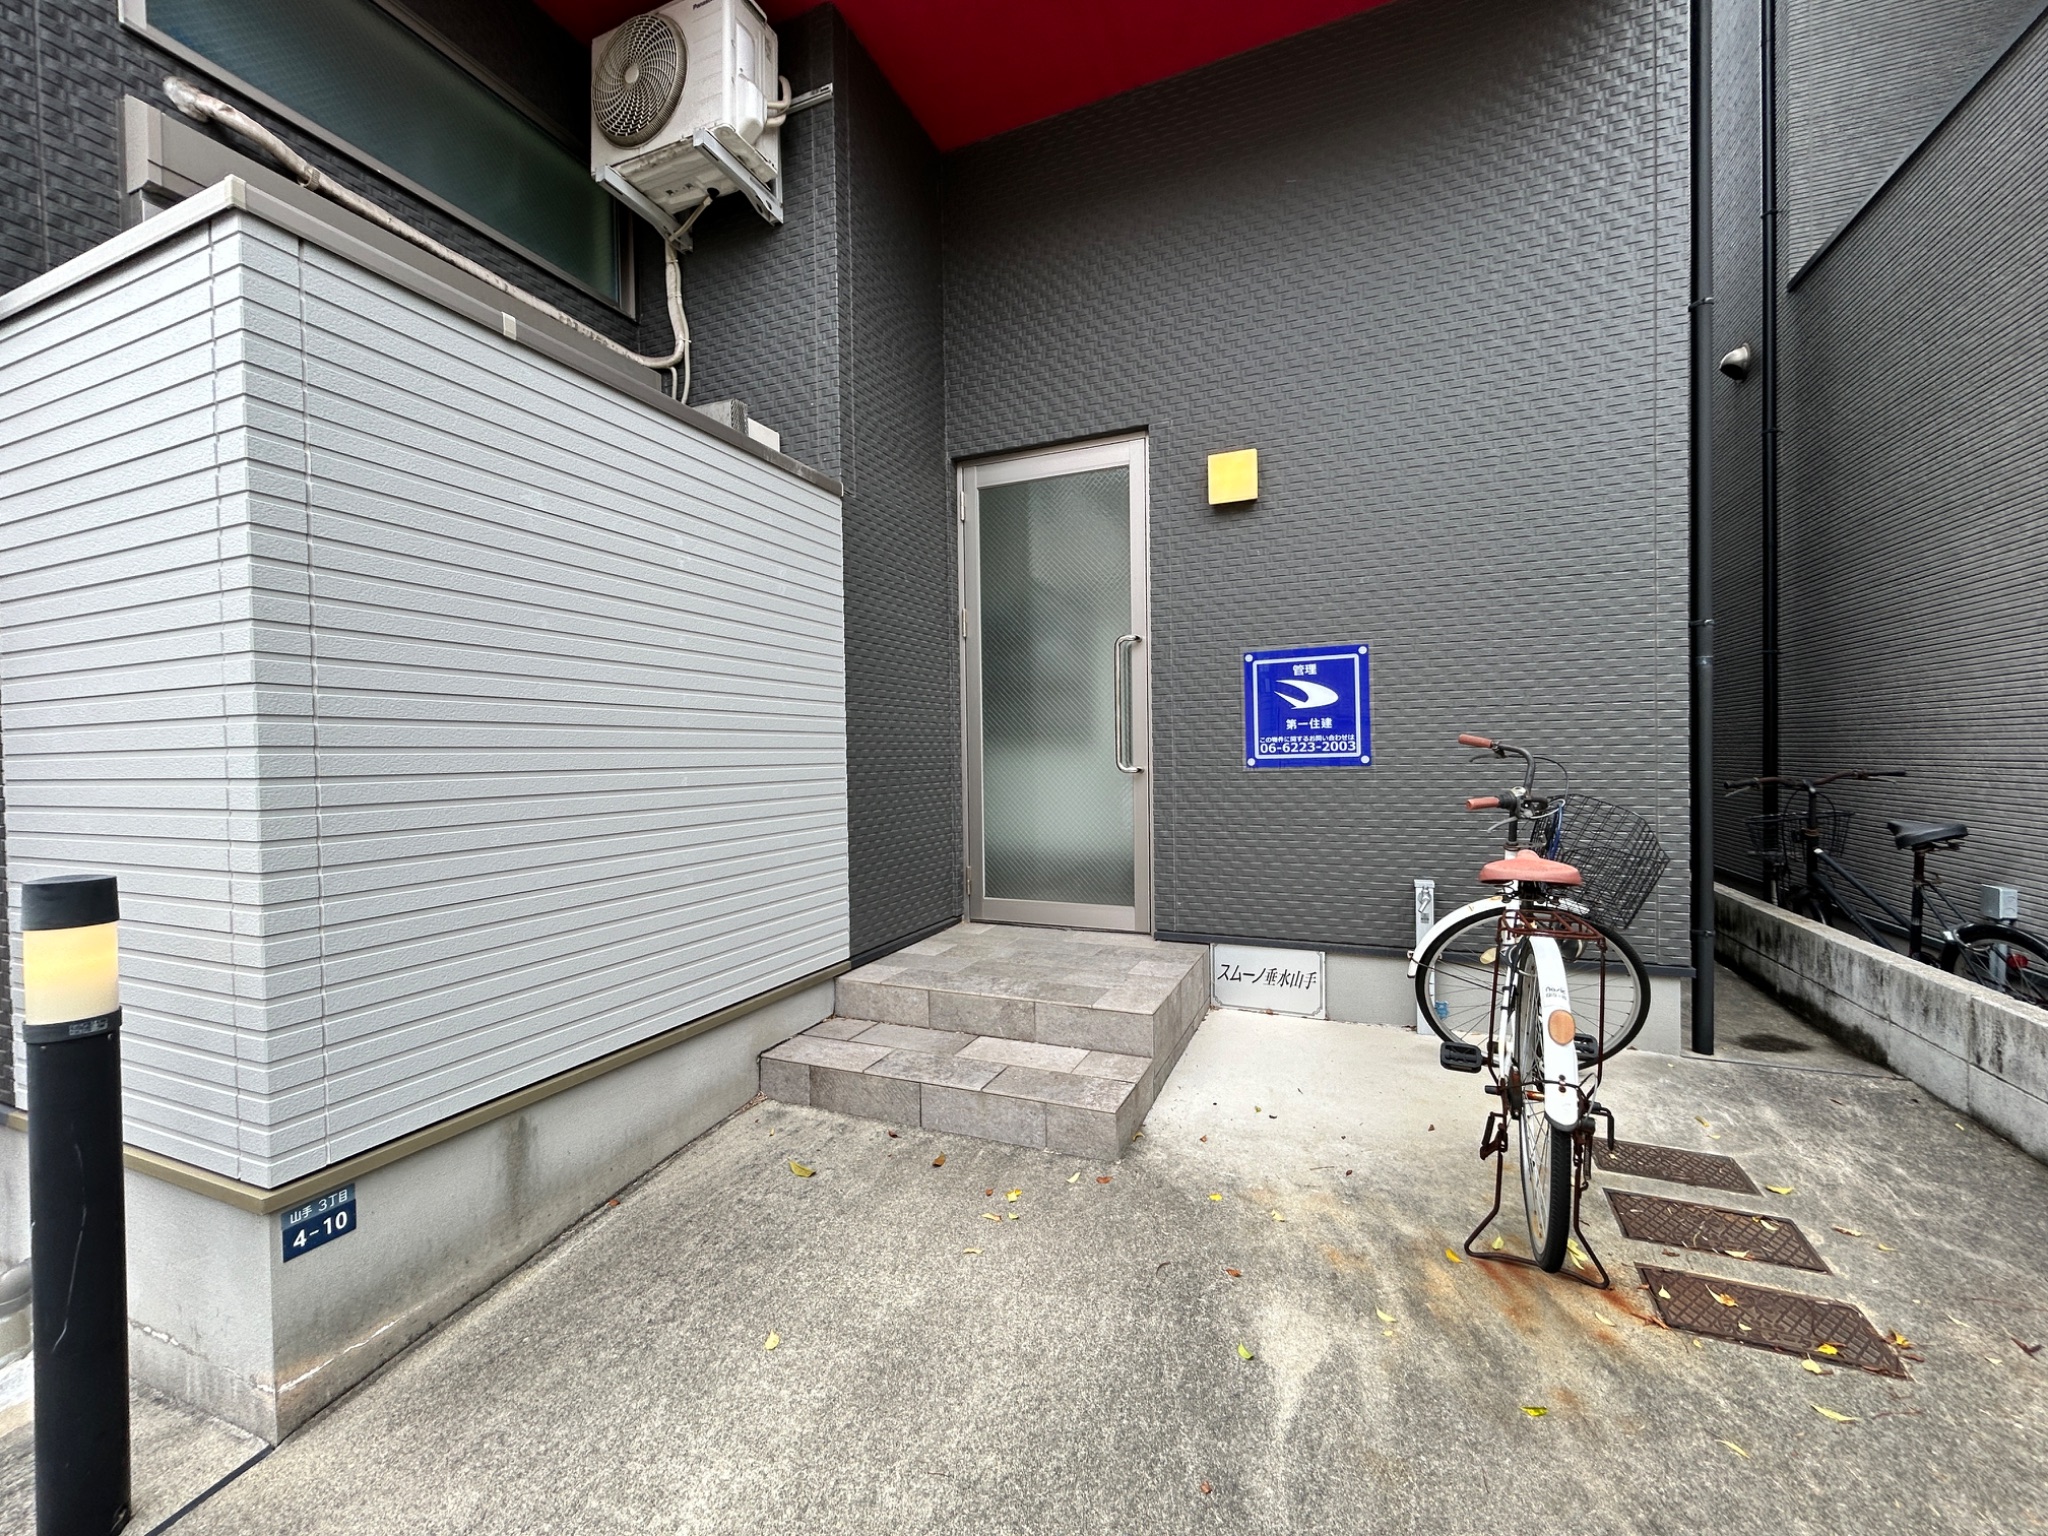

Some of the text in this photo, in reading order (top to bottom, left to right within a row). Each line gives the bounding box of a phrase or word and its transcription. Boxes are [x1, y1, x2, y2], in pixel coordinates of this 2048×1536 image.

[1292, 664, 1317, 676] 管理
[1286, 717, 1333, 730] 第一住建
[1260, 741, 1356, 753] 06-6223-2003
[1217, 964, 1317, 990] スムーノ垂水山手
[290, 1189, 348, 1224] 山手 3丁目
[293, 1211, 348, 1247] 4-10
